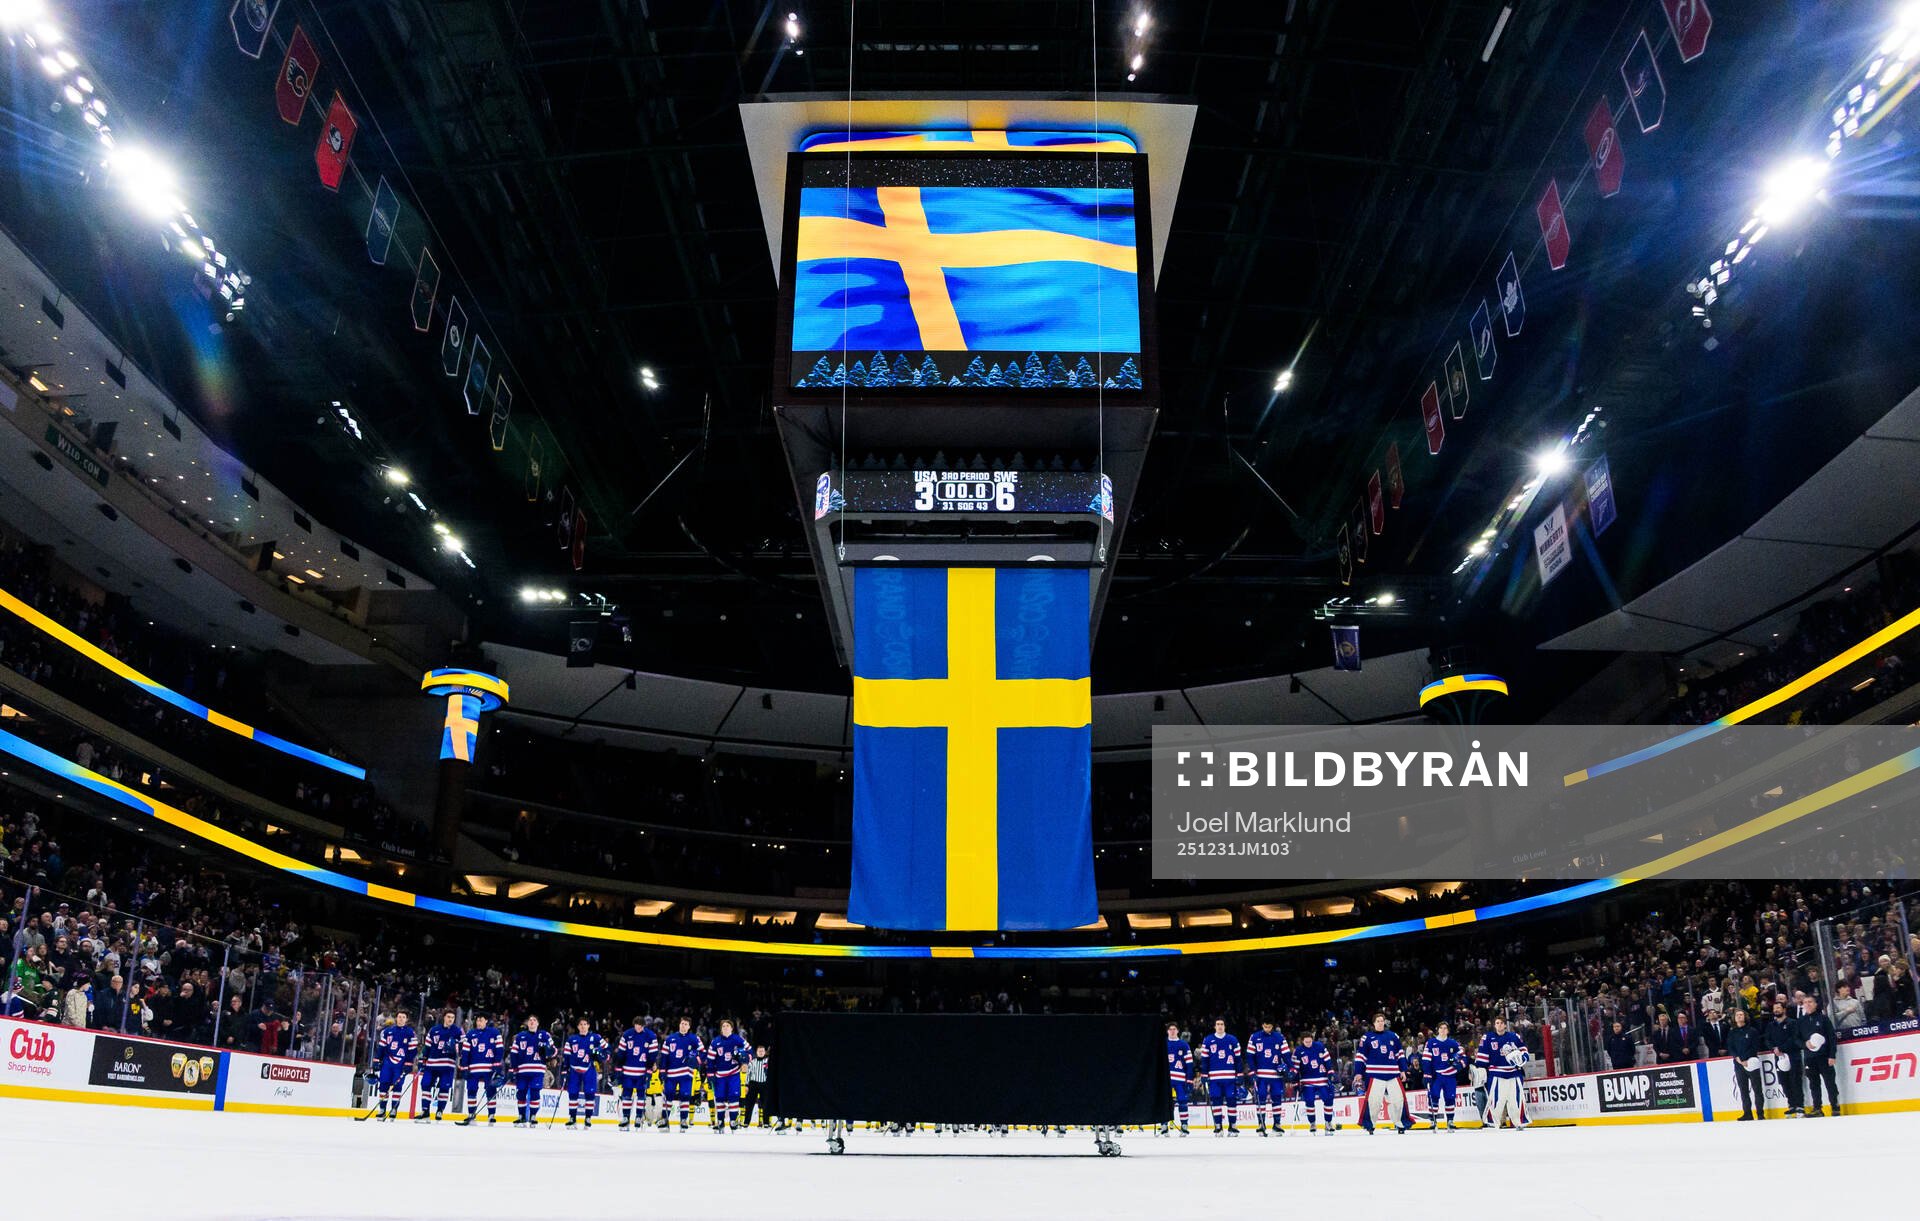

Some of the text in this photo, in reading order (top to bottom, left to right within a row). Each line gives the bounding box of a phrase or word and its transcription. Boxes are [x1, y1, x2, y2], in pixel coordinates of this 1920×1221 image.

[914, 471, 1018, 482] USA 3RD PERIOD SWE
[915, 482, 1015, 511] 3 00.0 6
[942, 502, 988, 511] 31 SOG 43
[10, 1028, 55, 1062] Cub
[8, 1061, 26, 1073] Shop
[114, 1061, 140, 1073] BARON
[272, 1067, 309, 1080] CHIPOTLE
[1850, 1052, 1917, 1083] TSN
[1539, 1083, 1585, 1103] TISSOT
[1603, 1075, 1650, 1102] BUMP
